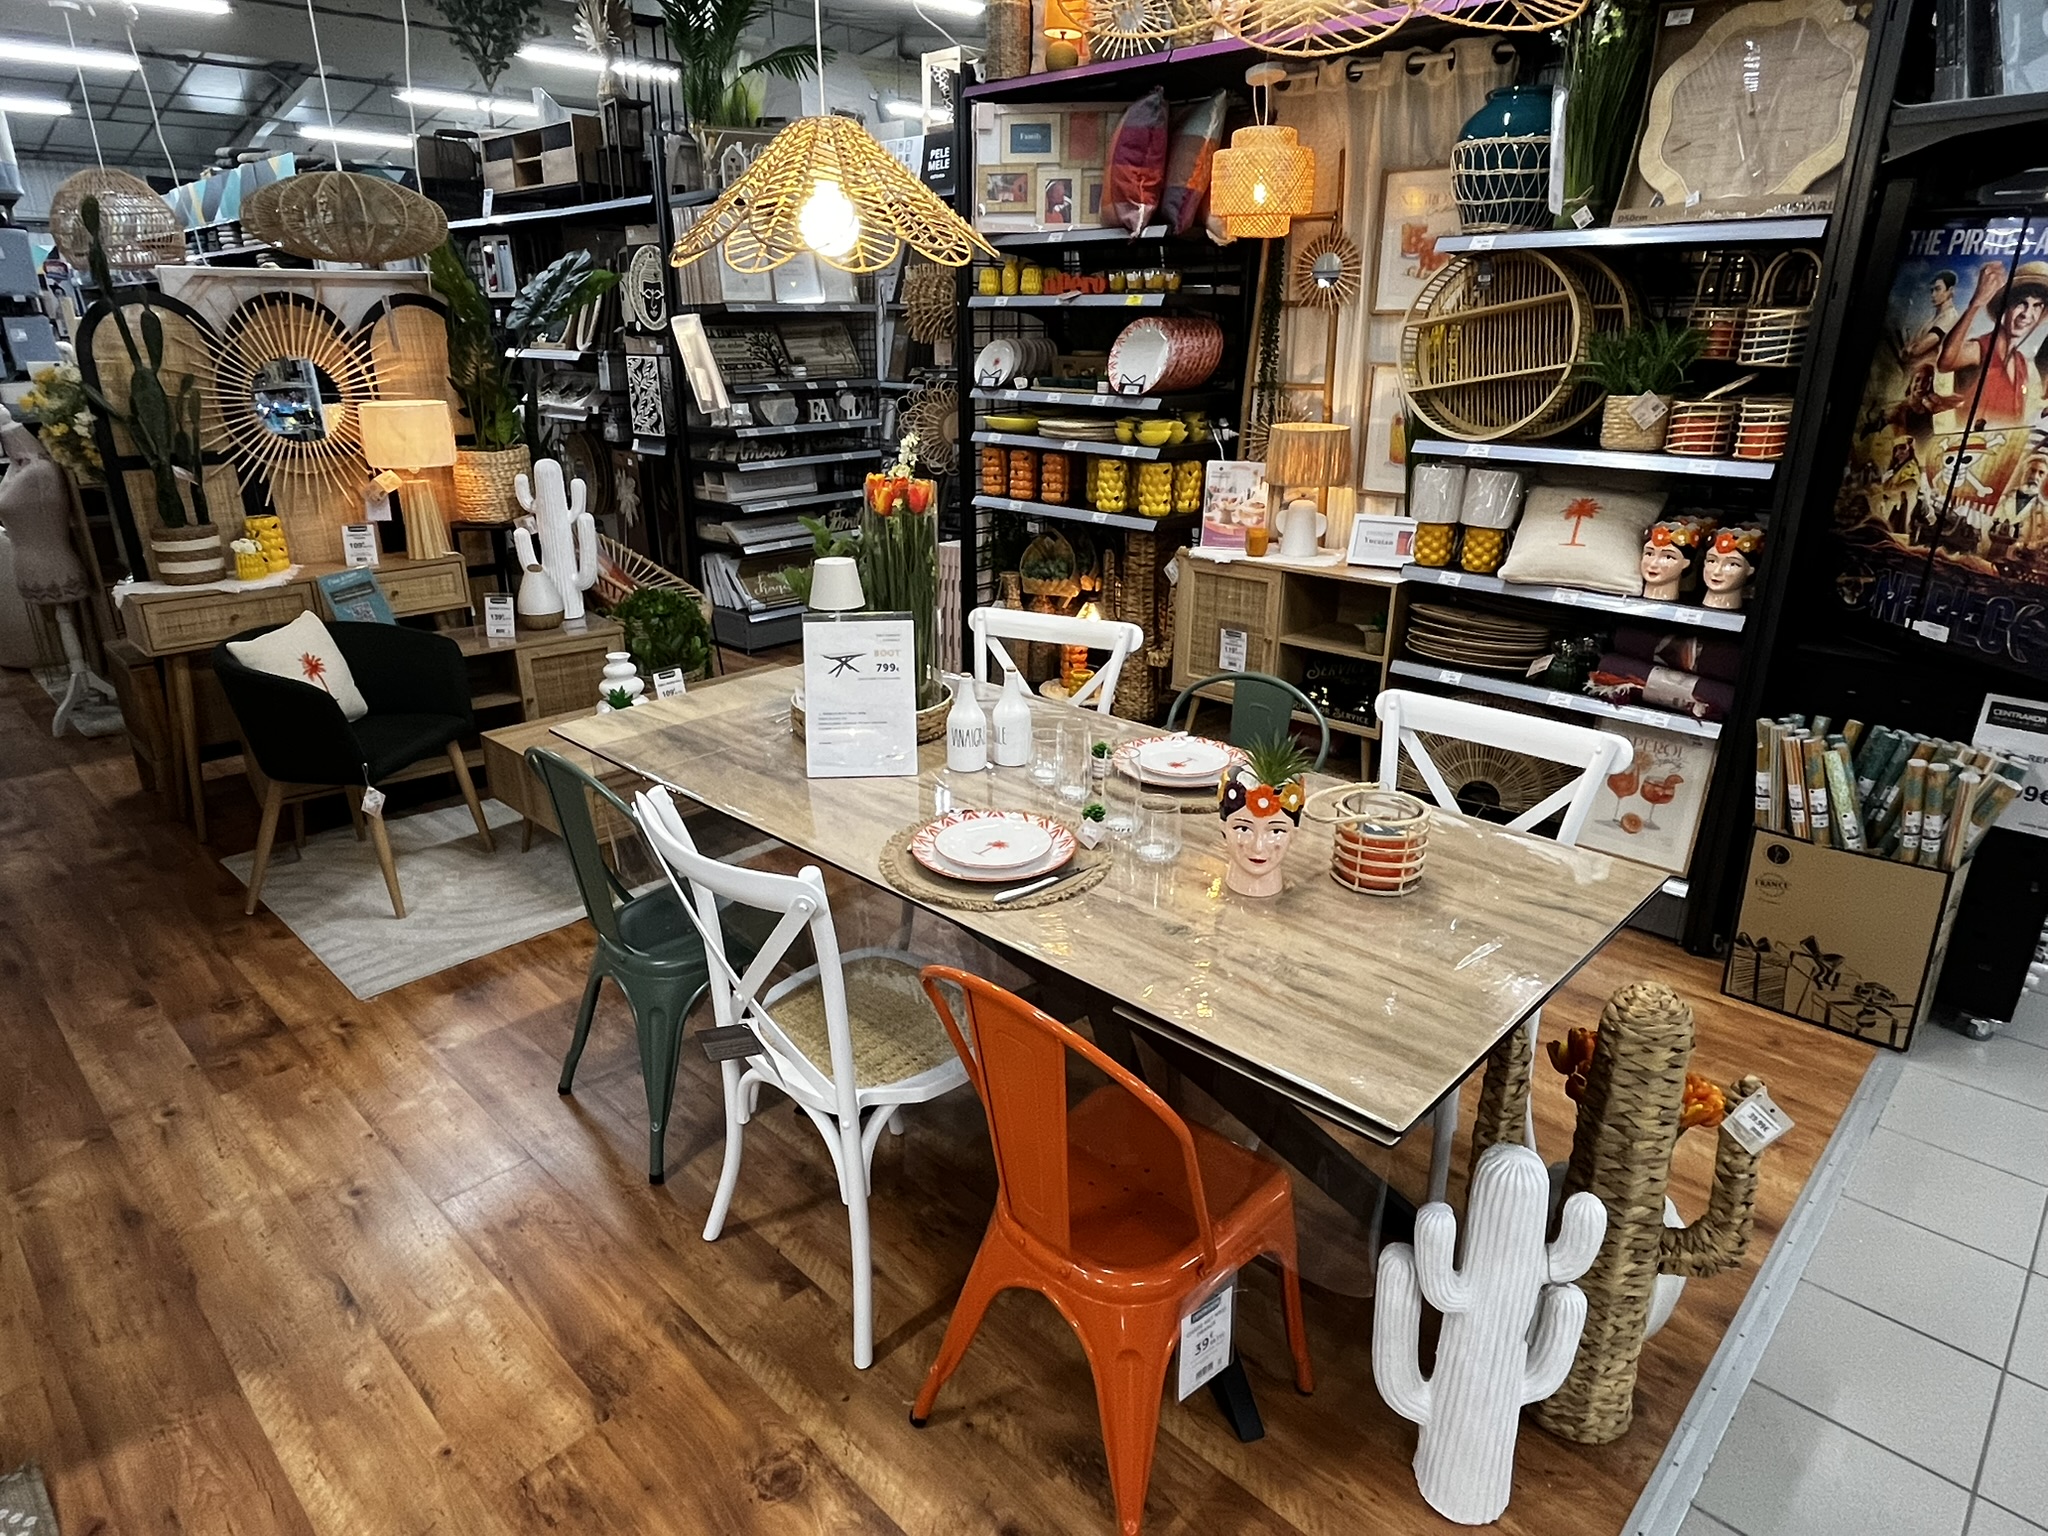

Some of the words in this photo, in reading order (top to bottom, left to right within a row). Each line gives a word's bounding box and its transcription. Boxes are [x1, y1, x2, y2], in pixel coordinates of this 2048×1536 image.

[930, 147, 950, 160] PELE
[928, 159, 950, 171] MELE
[1617, 214, 1648, 224] D50cm
[1909, 229, 1945, 256] THE
[1947, 227, 2036, 256] PIRATES
[873, 650, 900, 658] BOOT
